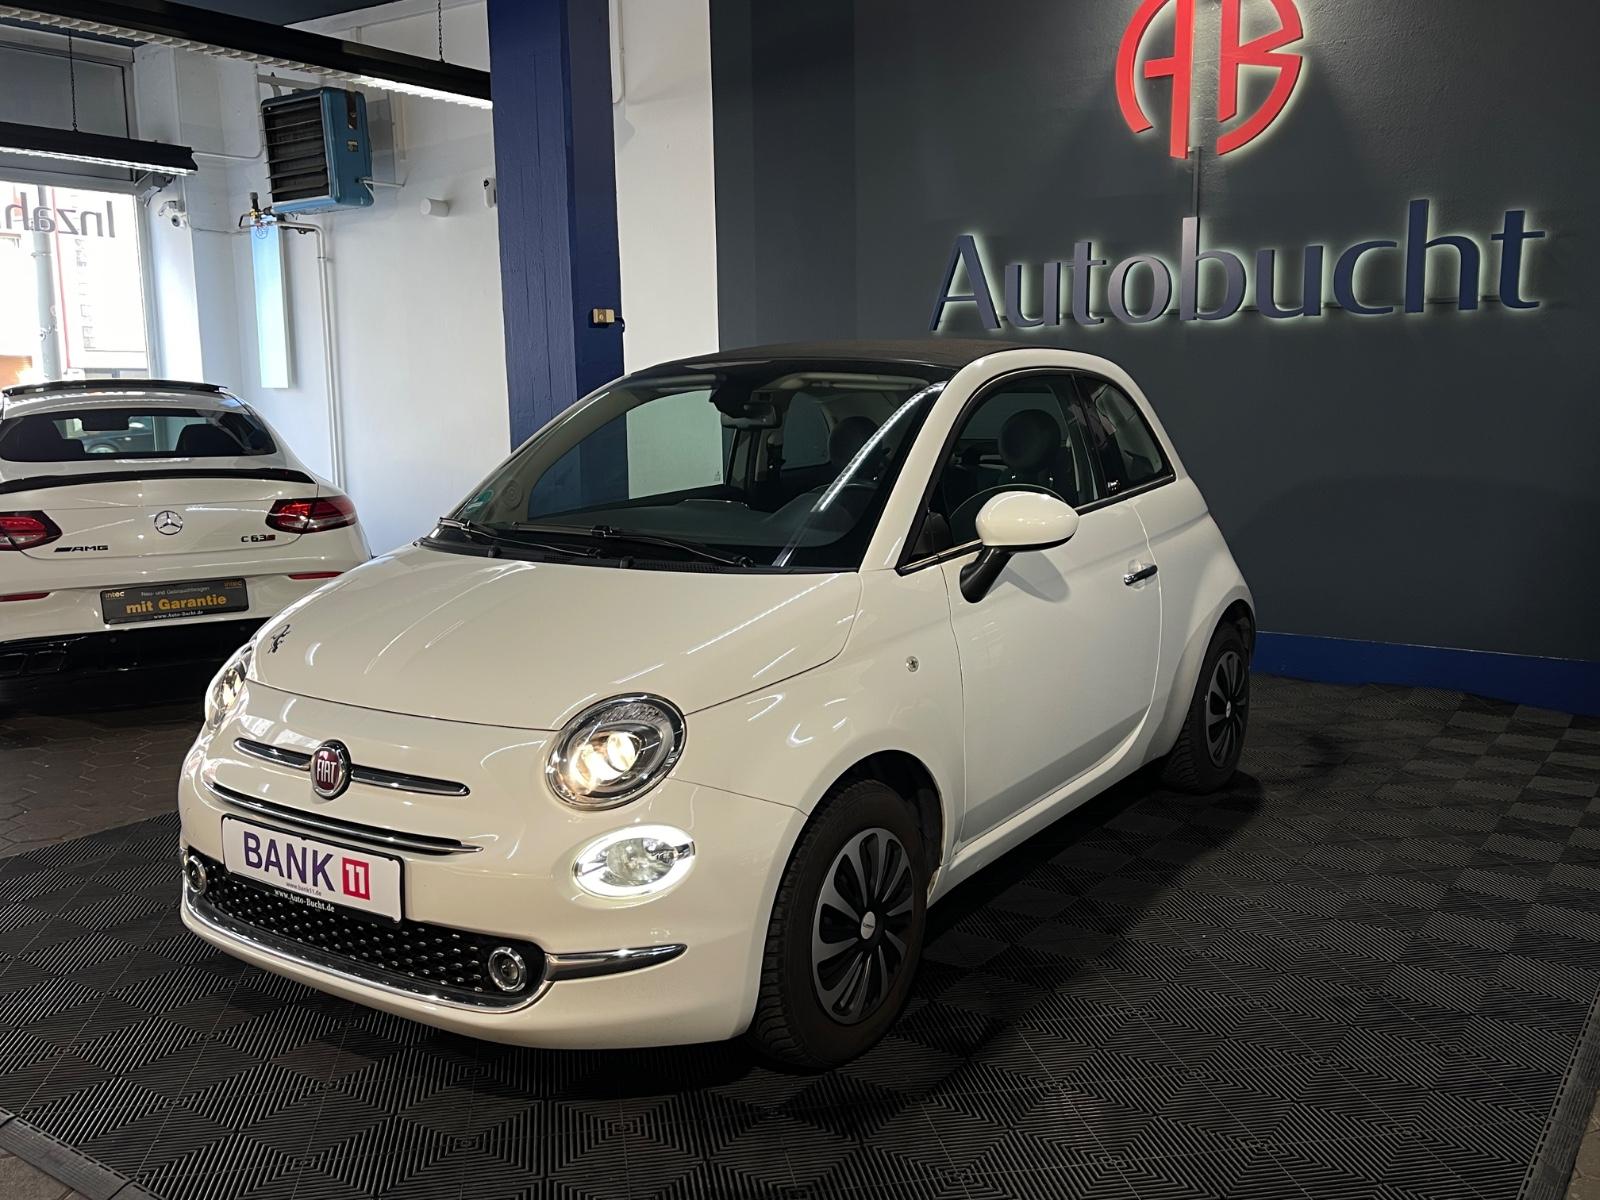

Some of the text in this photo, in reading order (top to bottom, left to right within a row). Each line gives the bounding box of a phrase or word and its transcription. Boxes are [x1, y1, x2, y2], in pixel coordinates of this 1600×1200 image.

[928, 198, 1546, 332] Autobucht
[70, 544, 109, 553] AMG
[126, 594, 227, 614] mit Garantie
[316, 758, 338, 785] FIAT
[243, 830, 366, 897] BANK 11
[274, 889, 335, 913] www.Auto-Bucht.de
